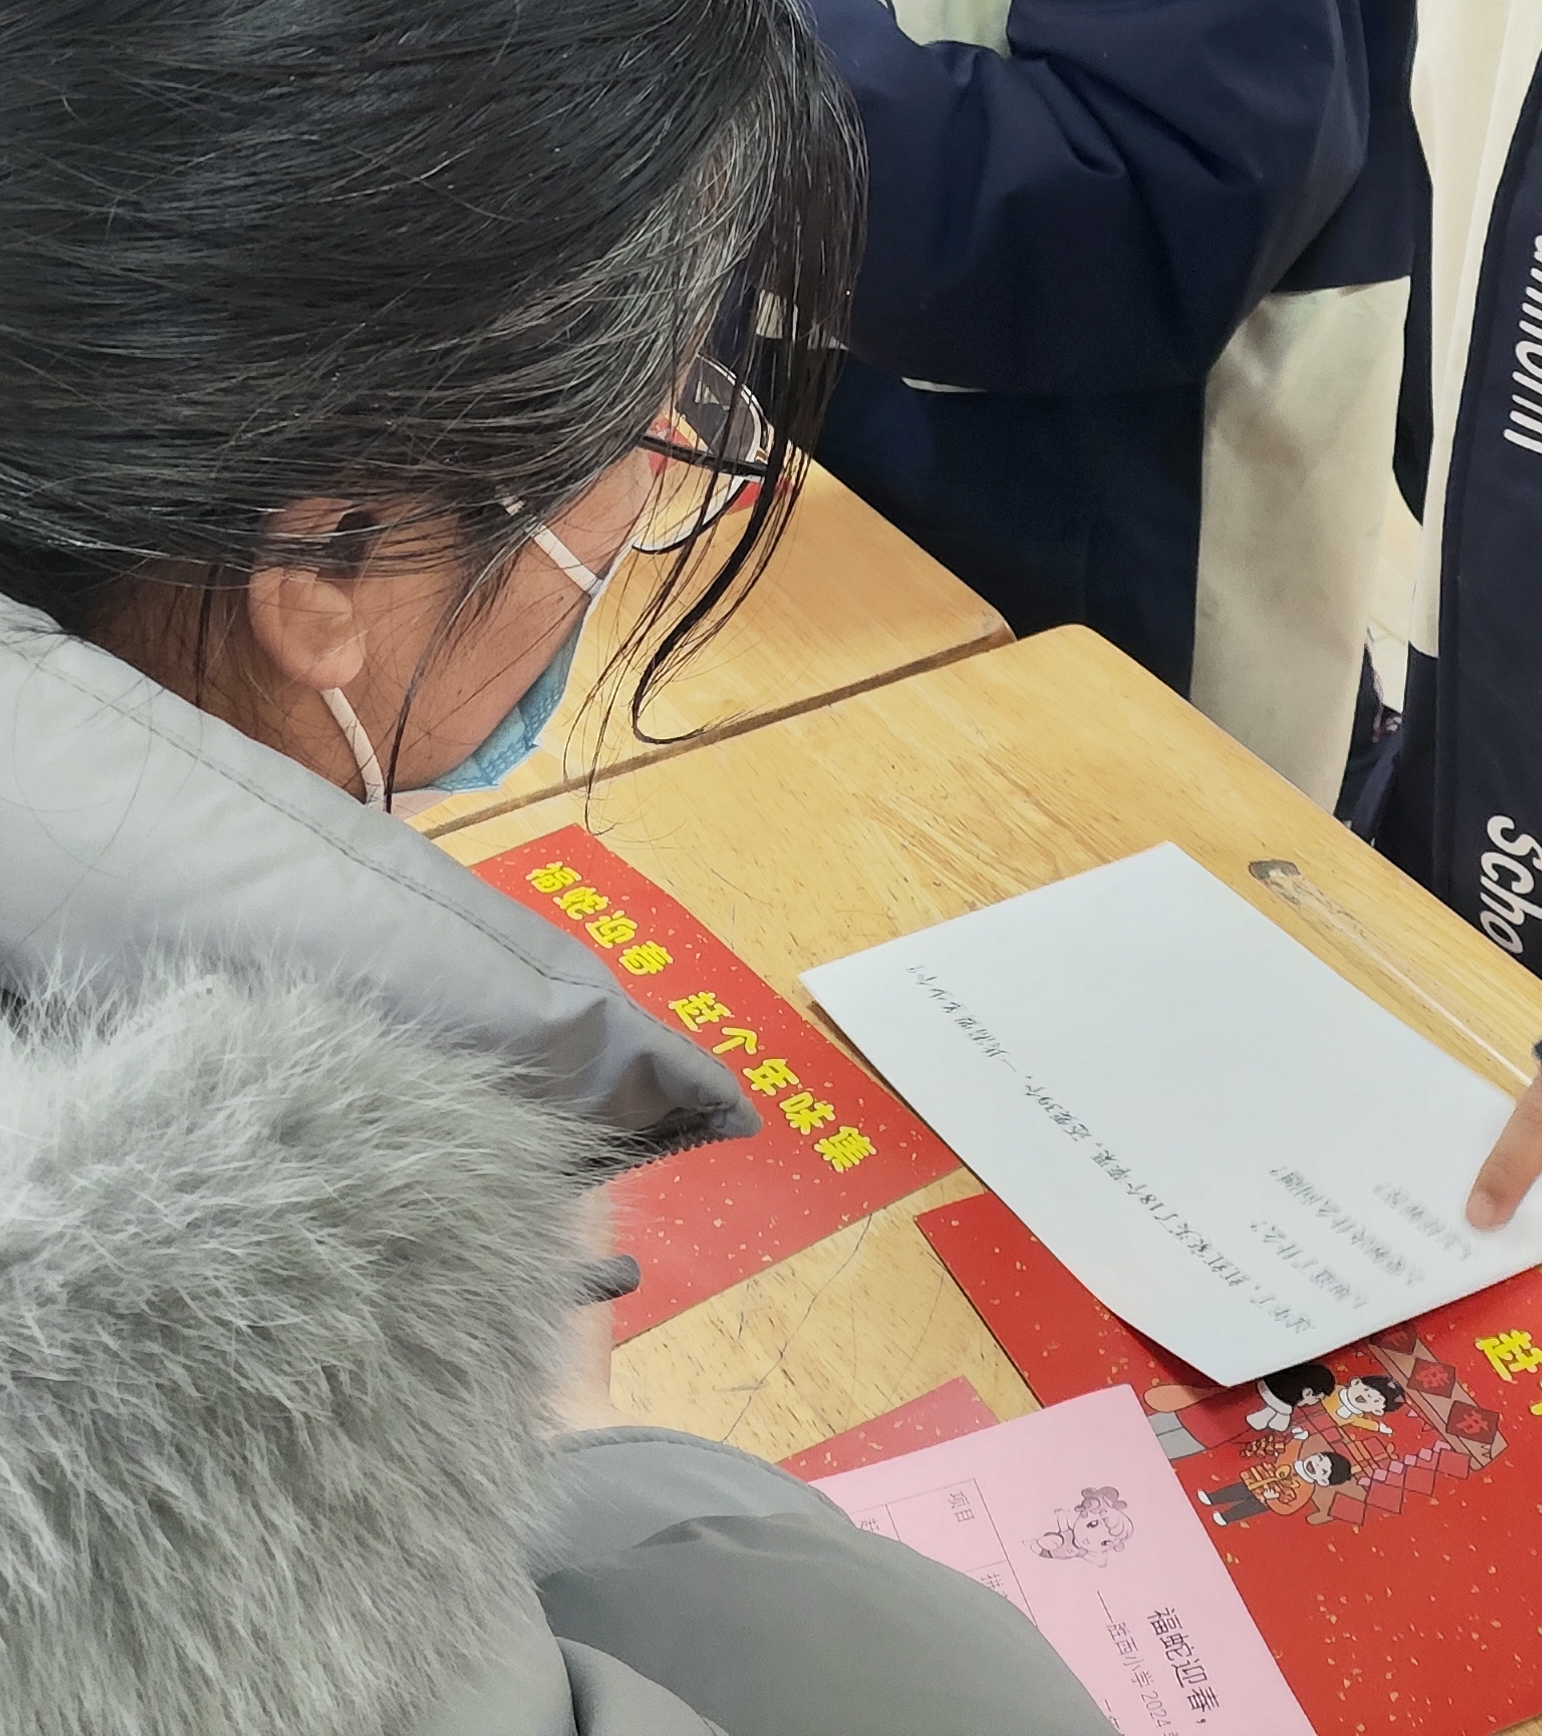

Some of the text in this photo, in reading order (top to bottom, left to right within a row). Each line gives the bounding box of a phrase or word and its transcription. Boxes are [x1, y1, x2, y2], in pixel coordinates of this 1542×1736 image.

[525, 861, 877, 1172] 福蛇迎春 赶个年味集
[947, 1490, 975, 1524] 项目
